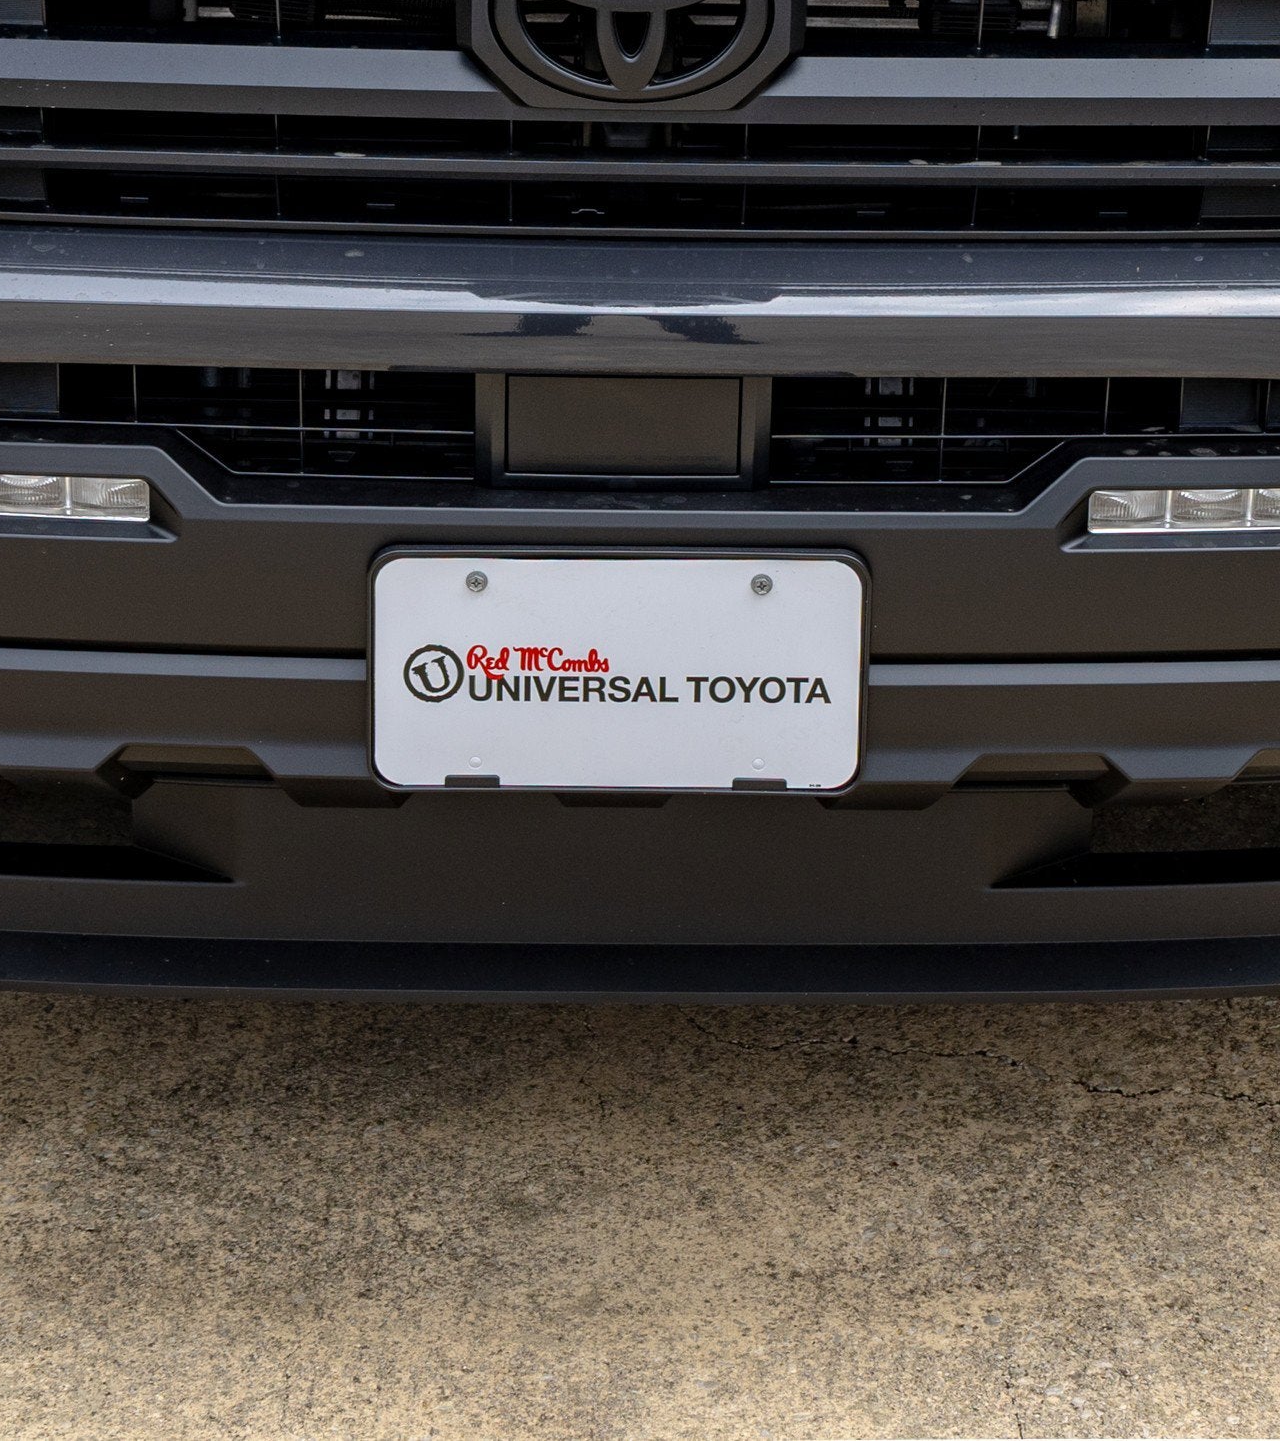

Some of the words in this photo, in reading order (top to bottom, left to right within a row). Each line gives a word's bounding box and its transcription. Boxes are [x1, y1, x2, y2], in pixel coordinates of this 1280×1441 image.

[466, 644, 510, 680] Red
[514, 645, 609, 673] McCombs
[469, 674, 679, 703] UNIVERSAL
[686, 676, 832, 704] TOYOTA
